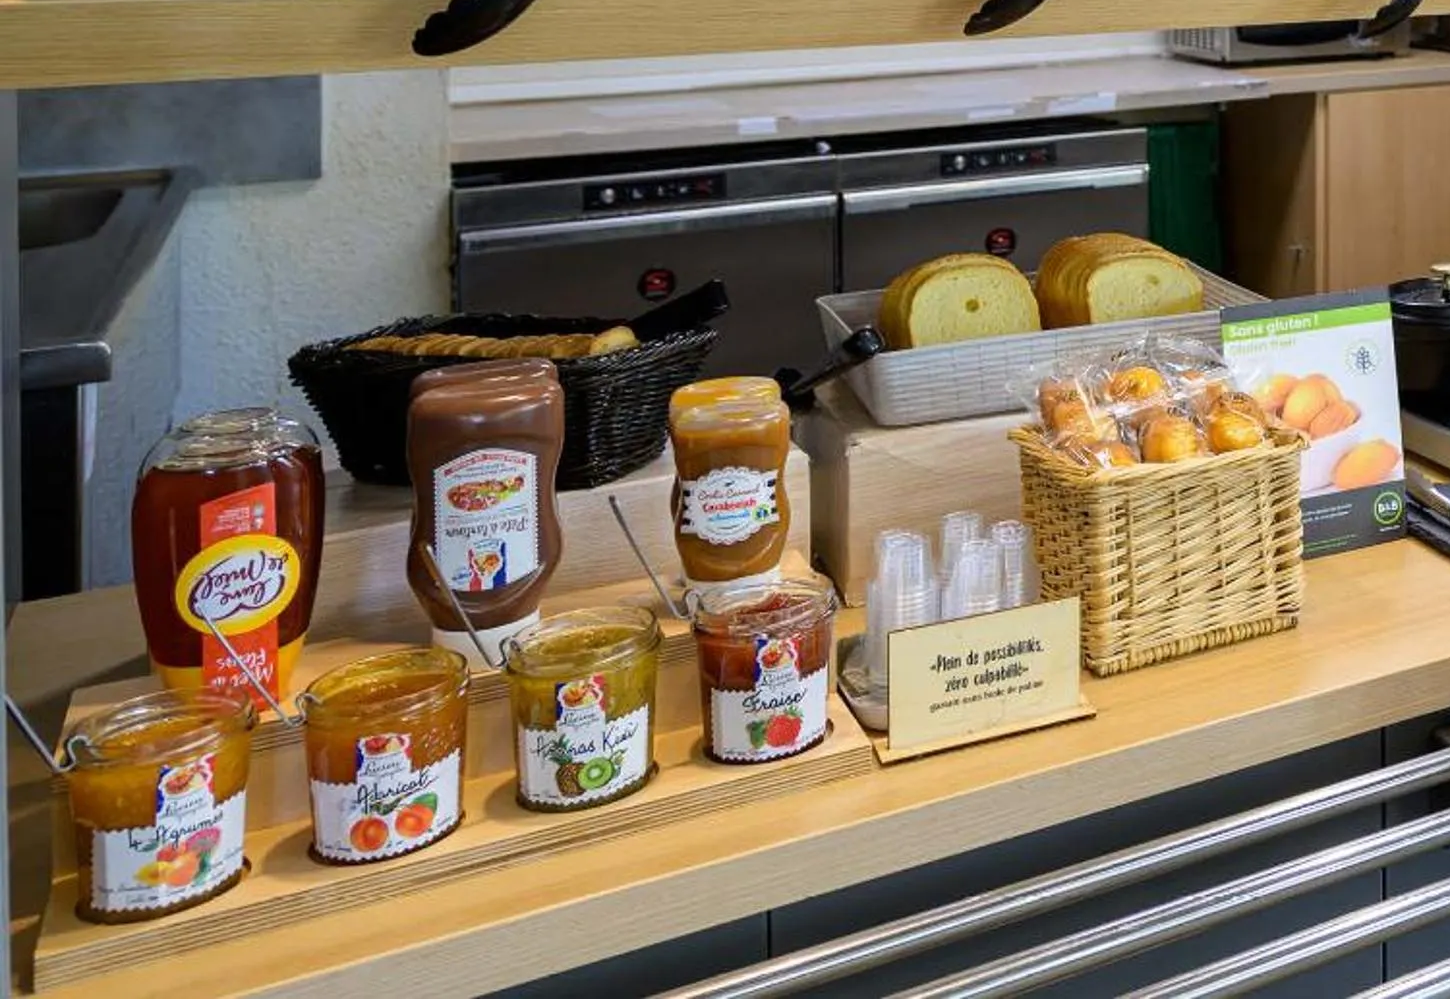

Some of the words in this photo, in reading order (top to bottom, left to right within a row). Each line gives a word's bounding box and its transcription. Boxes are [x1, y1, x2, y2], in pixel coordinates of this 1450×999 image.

[1229, 322, 1262, 339] Sans
[1266, 316, 1312, 338] gluten
[267, 553, 289, 573] de
[966, 650, 979, 665] de
[742, 688, 808, 714] Fraise
